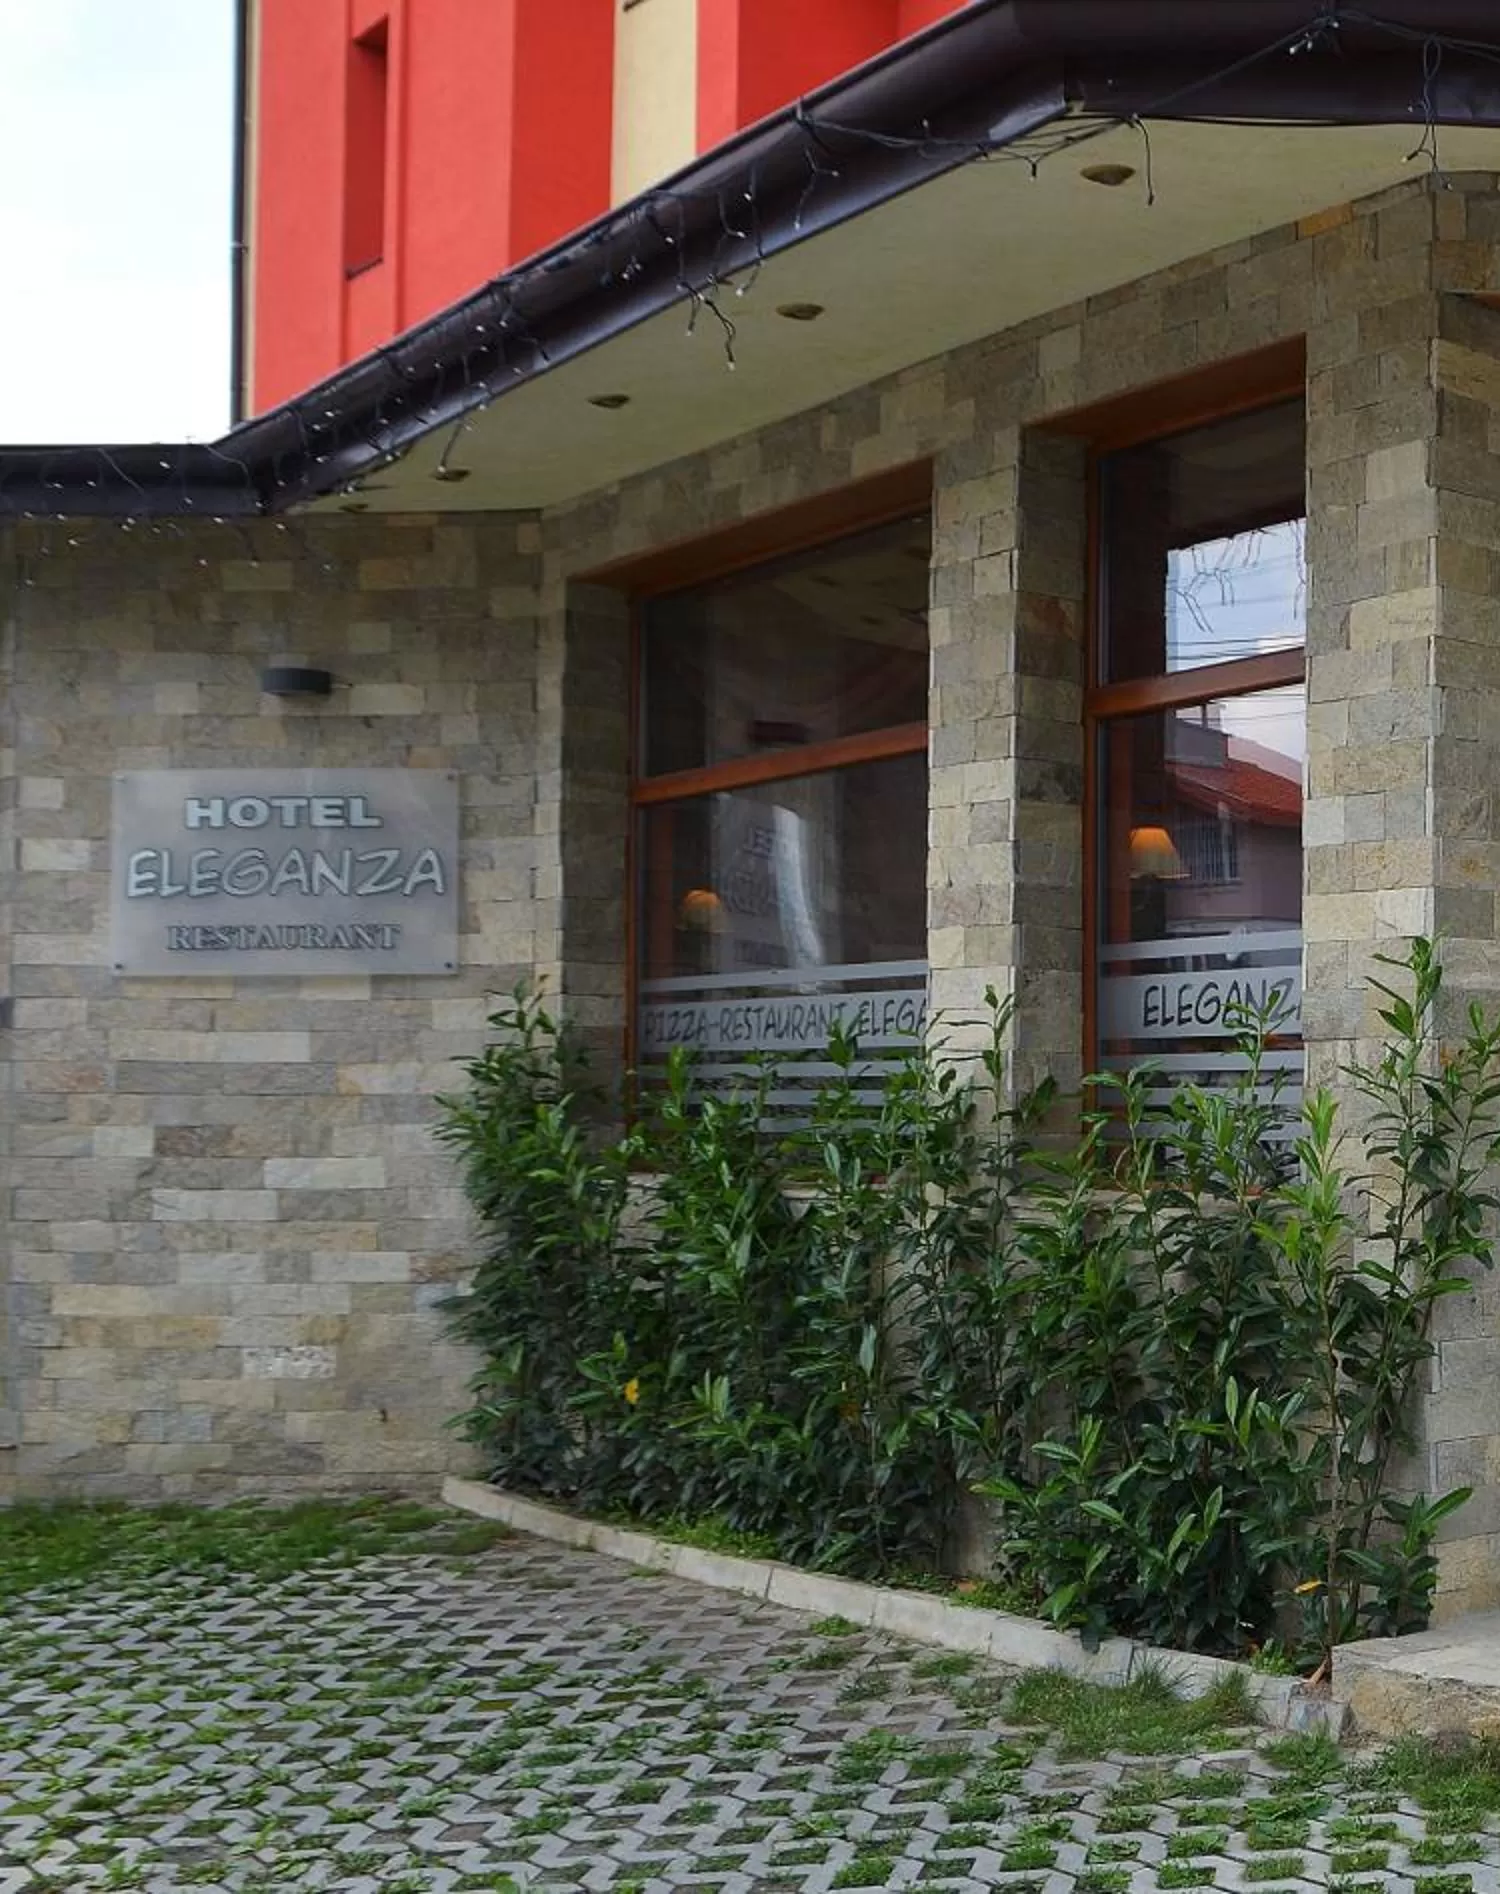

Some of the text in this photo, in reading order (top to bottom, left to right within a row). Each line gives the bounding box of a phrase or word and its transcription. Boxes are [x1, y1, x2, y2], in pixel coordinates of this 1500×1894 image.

[184, 796, 384, 829] HOTEL
[127, 848, 446, 898] ELEGANZA
[166, 923, 403, 951] RESTAURANT
[1143, 978, 1301, 1027] ELEGANZ
